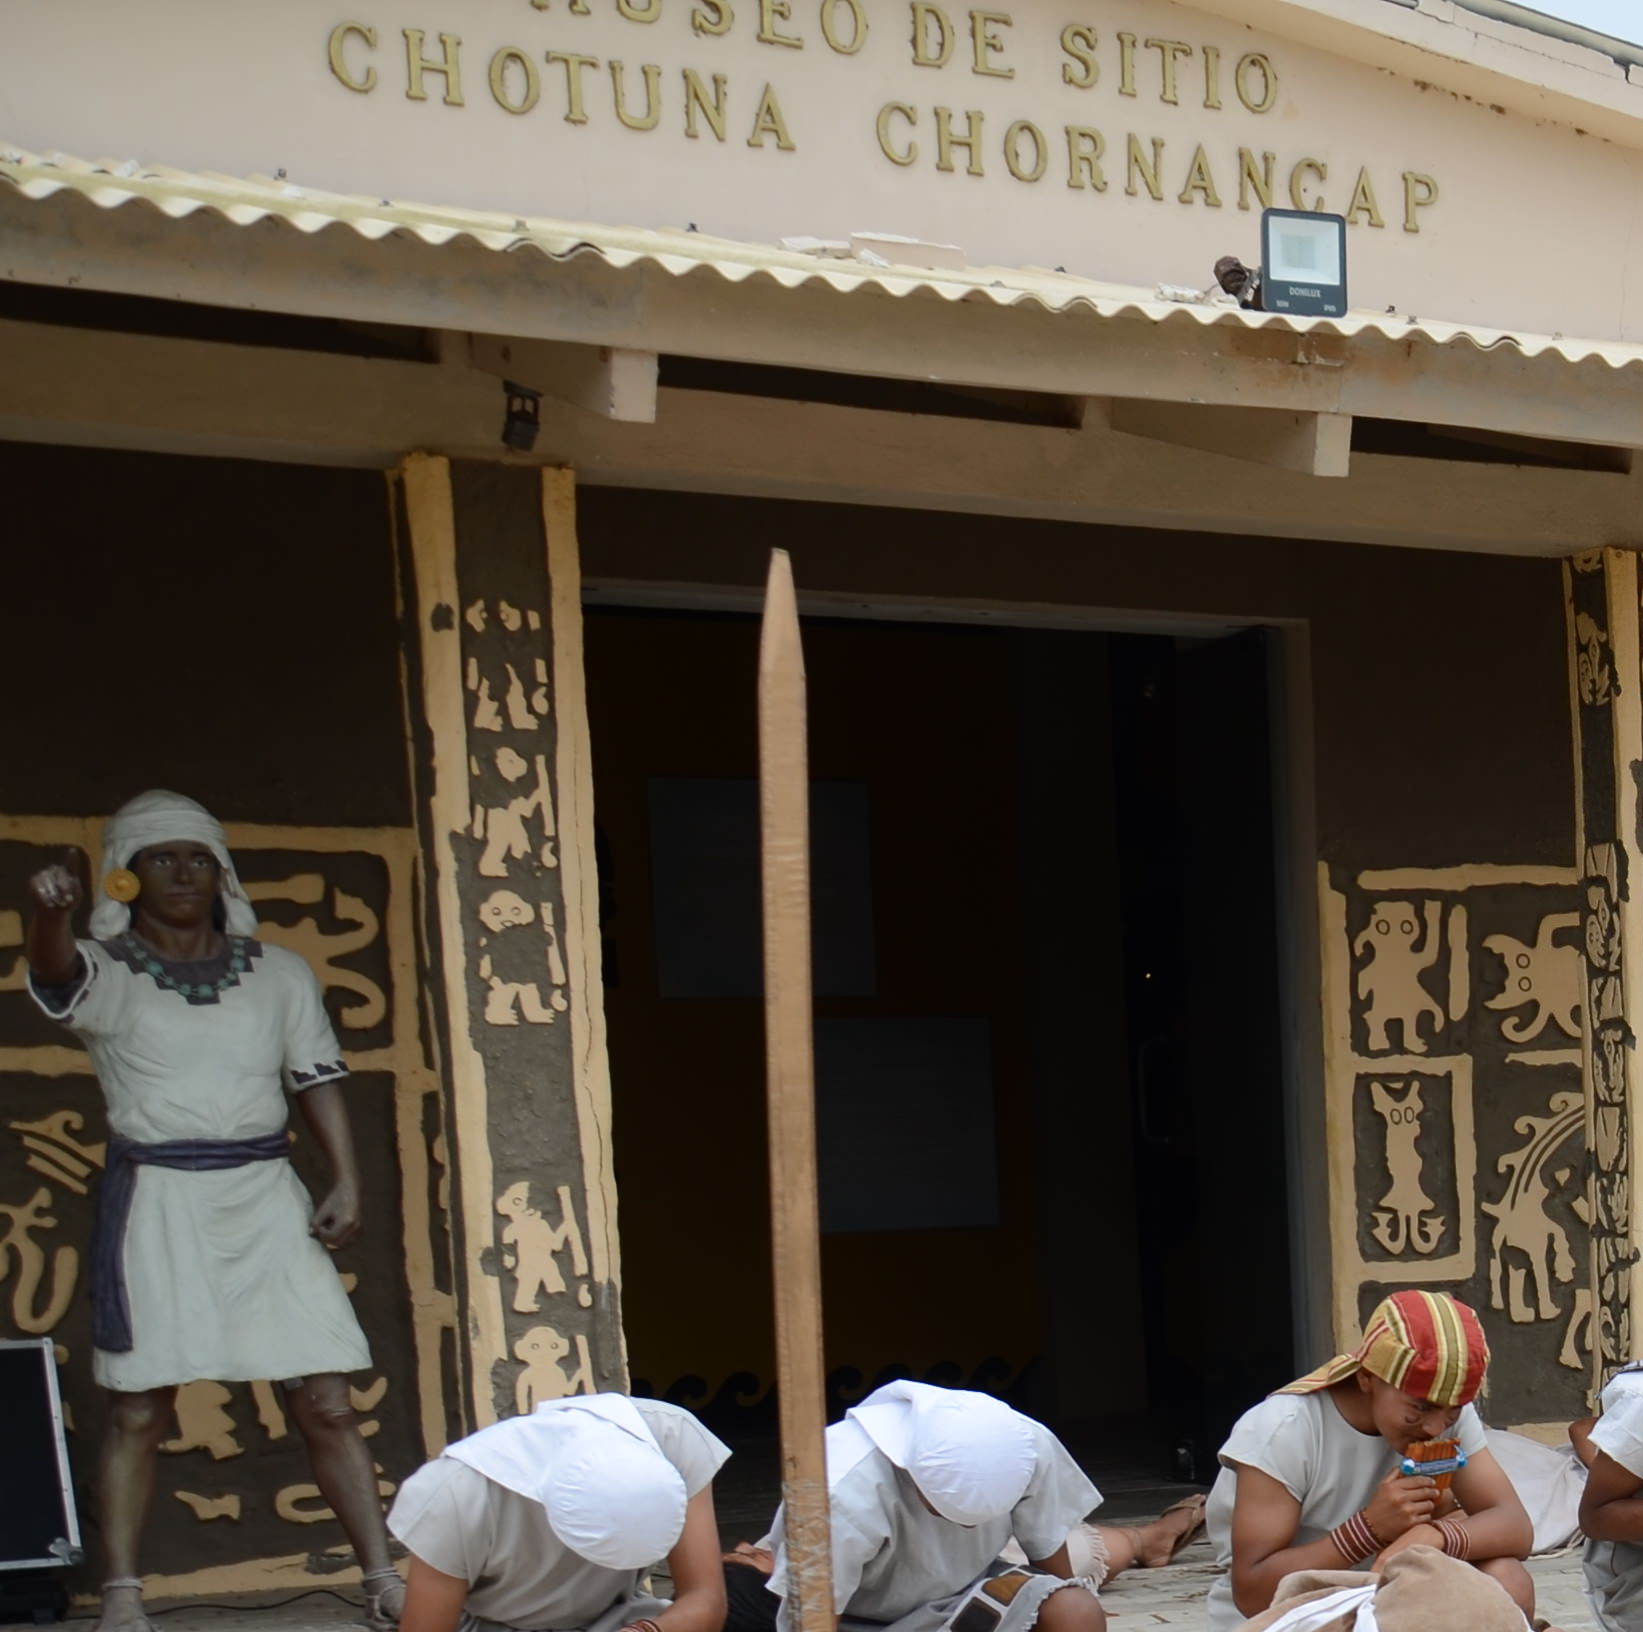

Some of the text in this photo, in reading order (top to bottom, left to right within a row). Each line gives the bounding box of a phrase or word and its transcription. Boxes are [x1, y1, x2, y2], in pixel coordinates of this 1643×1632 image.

[327, 19, 1440, 233] CHOTUNA CHORNANCAP
[528, 0, 1278, 115] SEO DE SITIO
